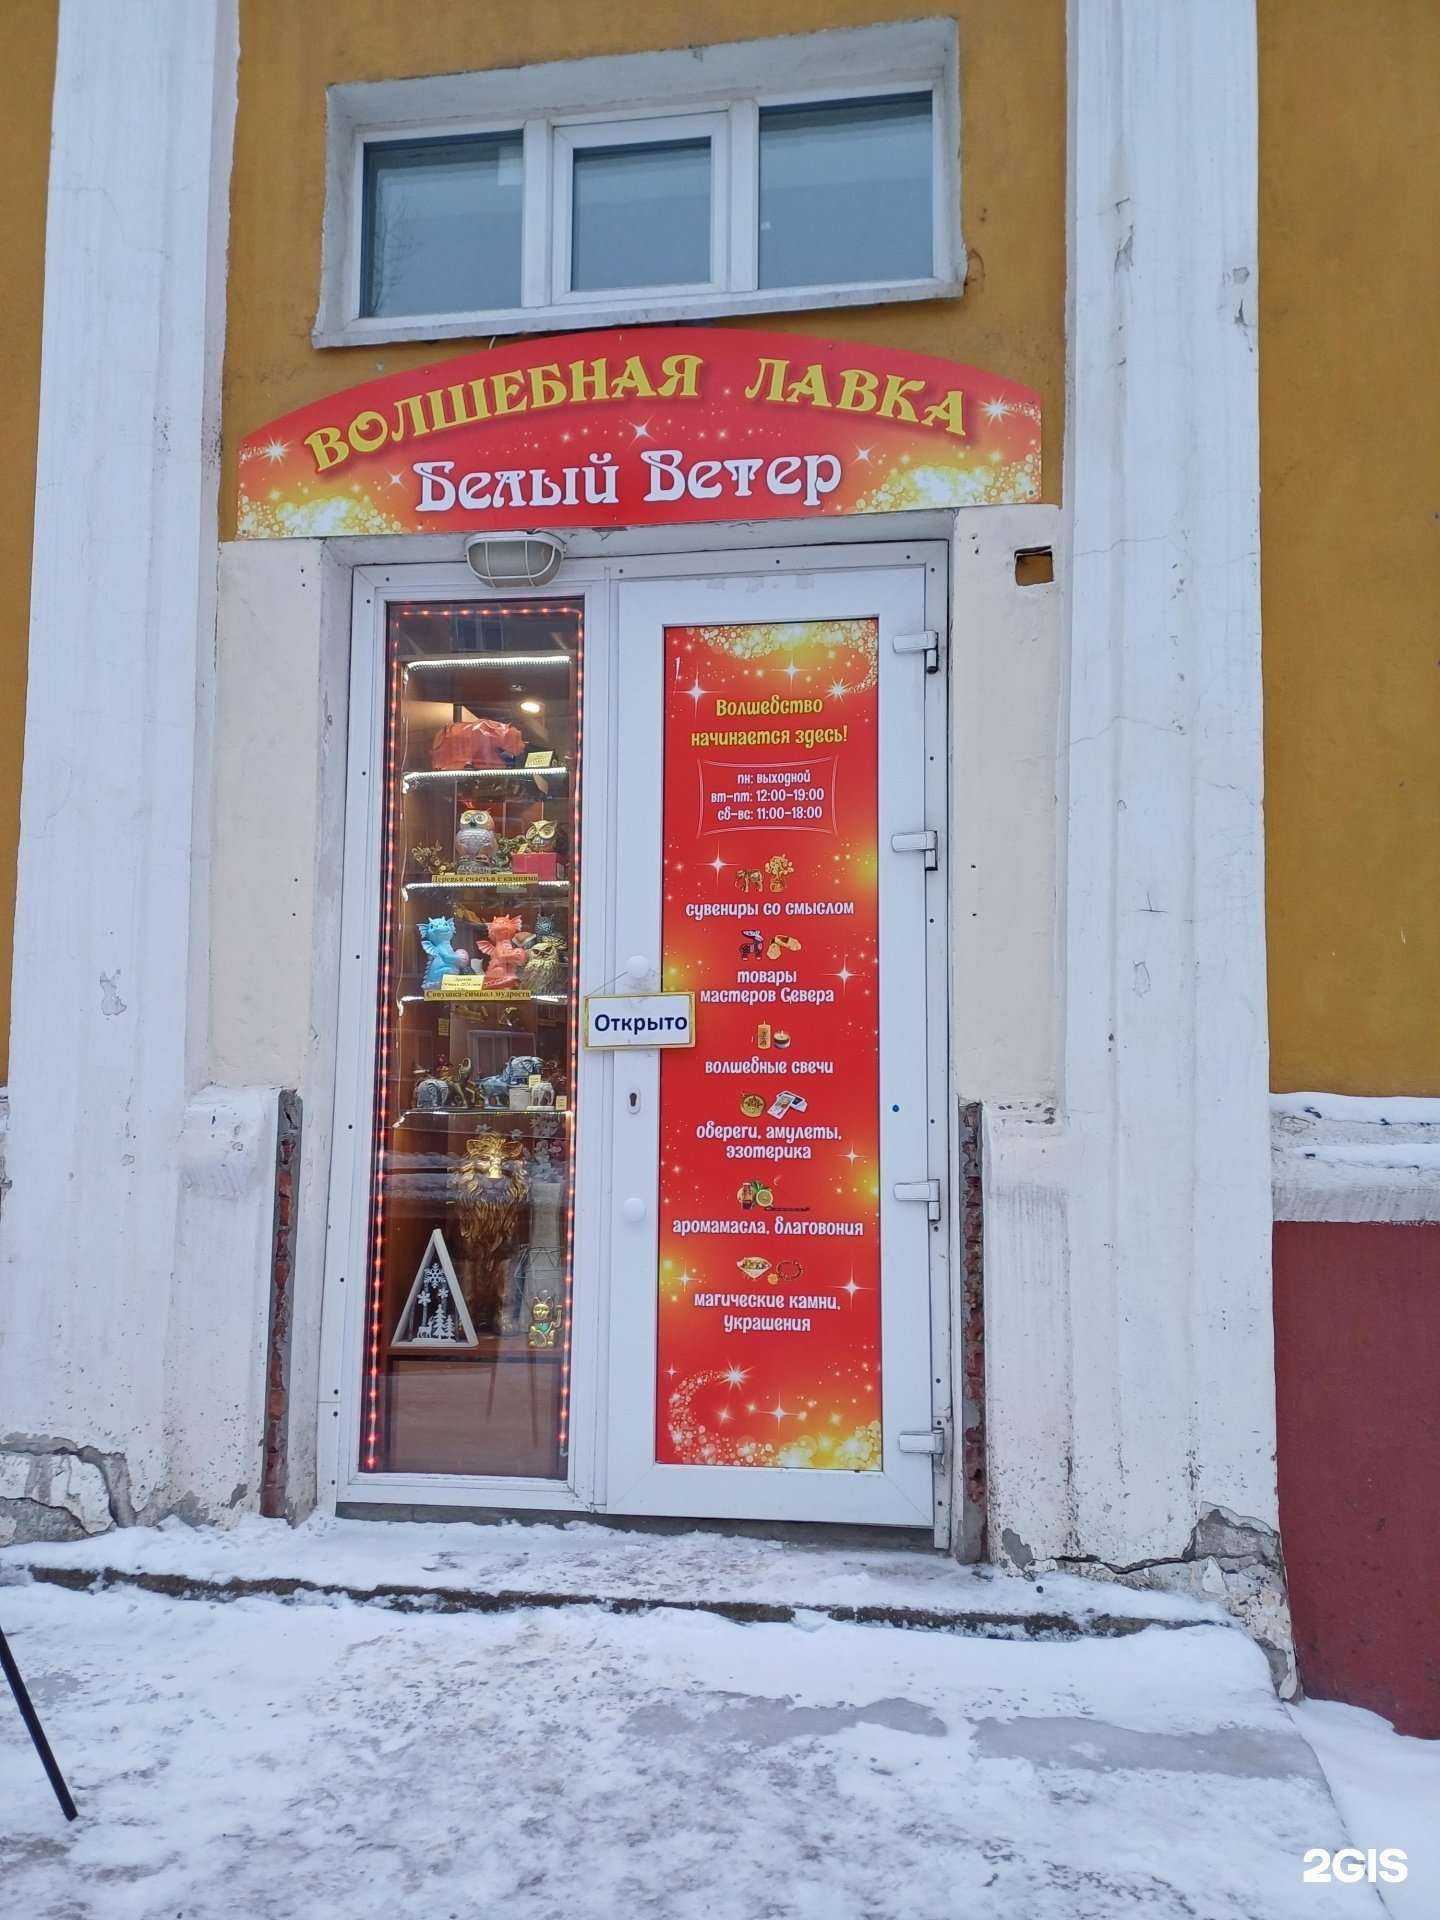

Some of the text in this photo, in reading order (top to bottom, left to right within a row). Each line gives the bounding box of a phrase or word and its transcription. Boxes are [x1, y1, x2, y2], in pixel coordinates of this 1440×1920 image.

[304, 354, 966, 472] ВОЛШЕБНАЯ ЛАВКА
[412, 449, 842, 512] Белый Ветер
[716, 695, 823, 717] Волшебство
[691, 725, 848, 748] начинается здесь!
[737, 769, 811, 787] пн: выходной
[756, 788, 825, 802] 12:00-19:00
[717, 806, 822, 820] сб-вс: 11:00-18:00
[685, 902, 854, 920] сувениры со смыслом
[737, 970, 797, 985] товары
[700, 987, 835, 1005] мастеров Севера
[594, 1014, 688, 1035] Открыто
[705, 1056, 834, 1074] волшебные свечи
[726, 1145, 812, 1162] эзотерика
[672, 1216, 864, 1236] аромамасла, благовония
[694, 1293, 785, 1310] магические
